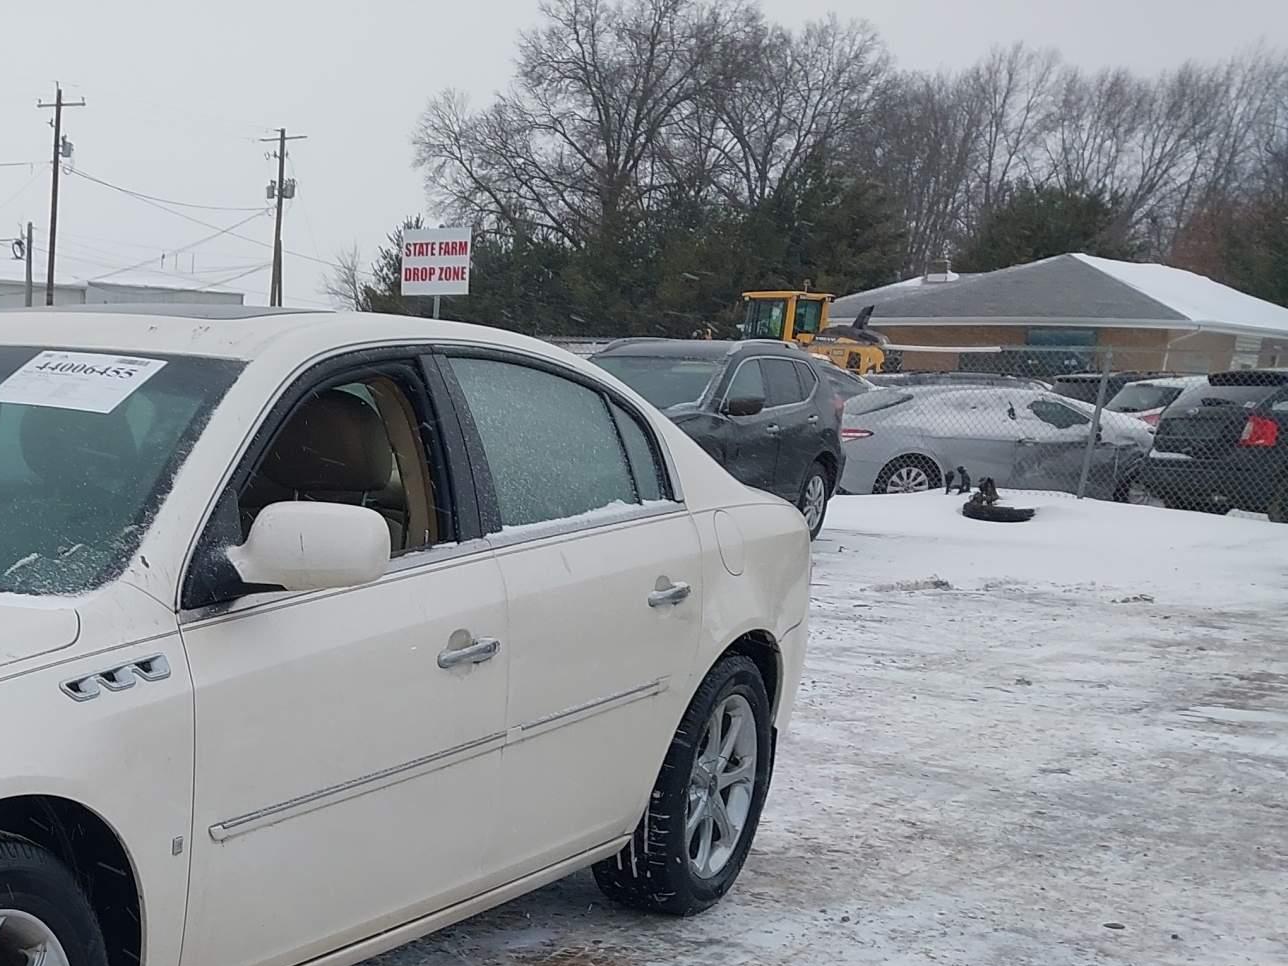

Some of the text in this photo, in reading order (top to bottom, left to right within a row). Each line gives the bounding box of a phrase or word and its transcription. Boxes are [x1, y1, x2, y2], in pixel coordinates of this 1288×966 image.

[404, 240, 469, 258] STATE FARM
[404, 265, 467, 282] DROP ZONE
[35, 360, 139, 379] 44006455
